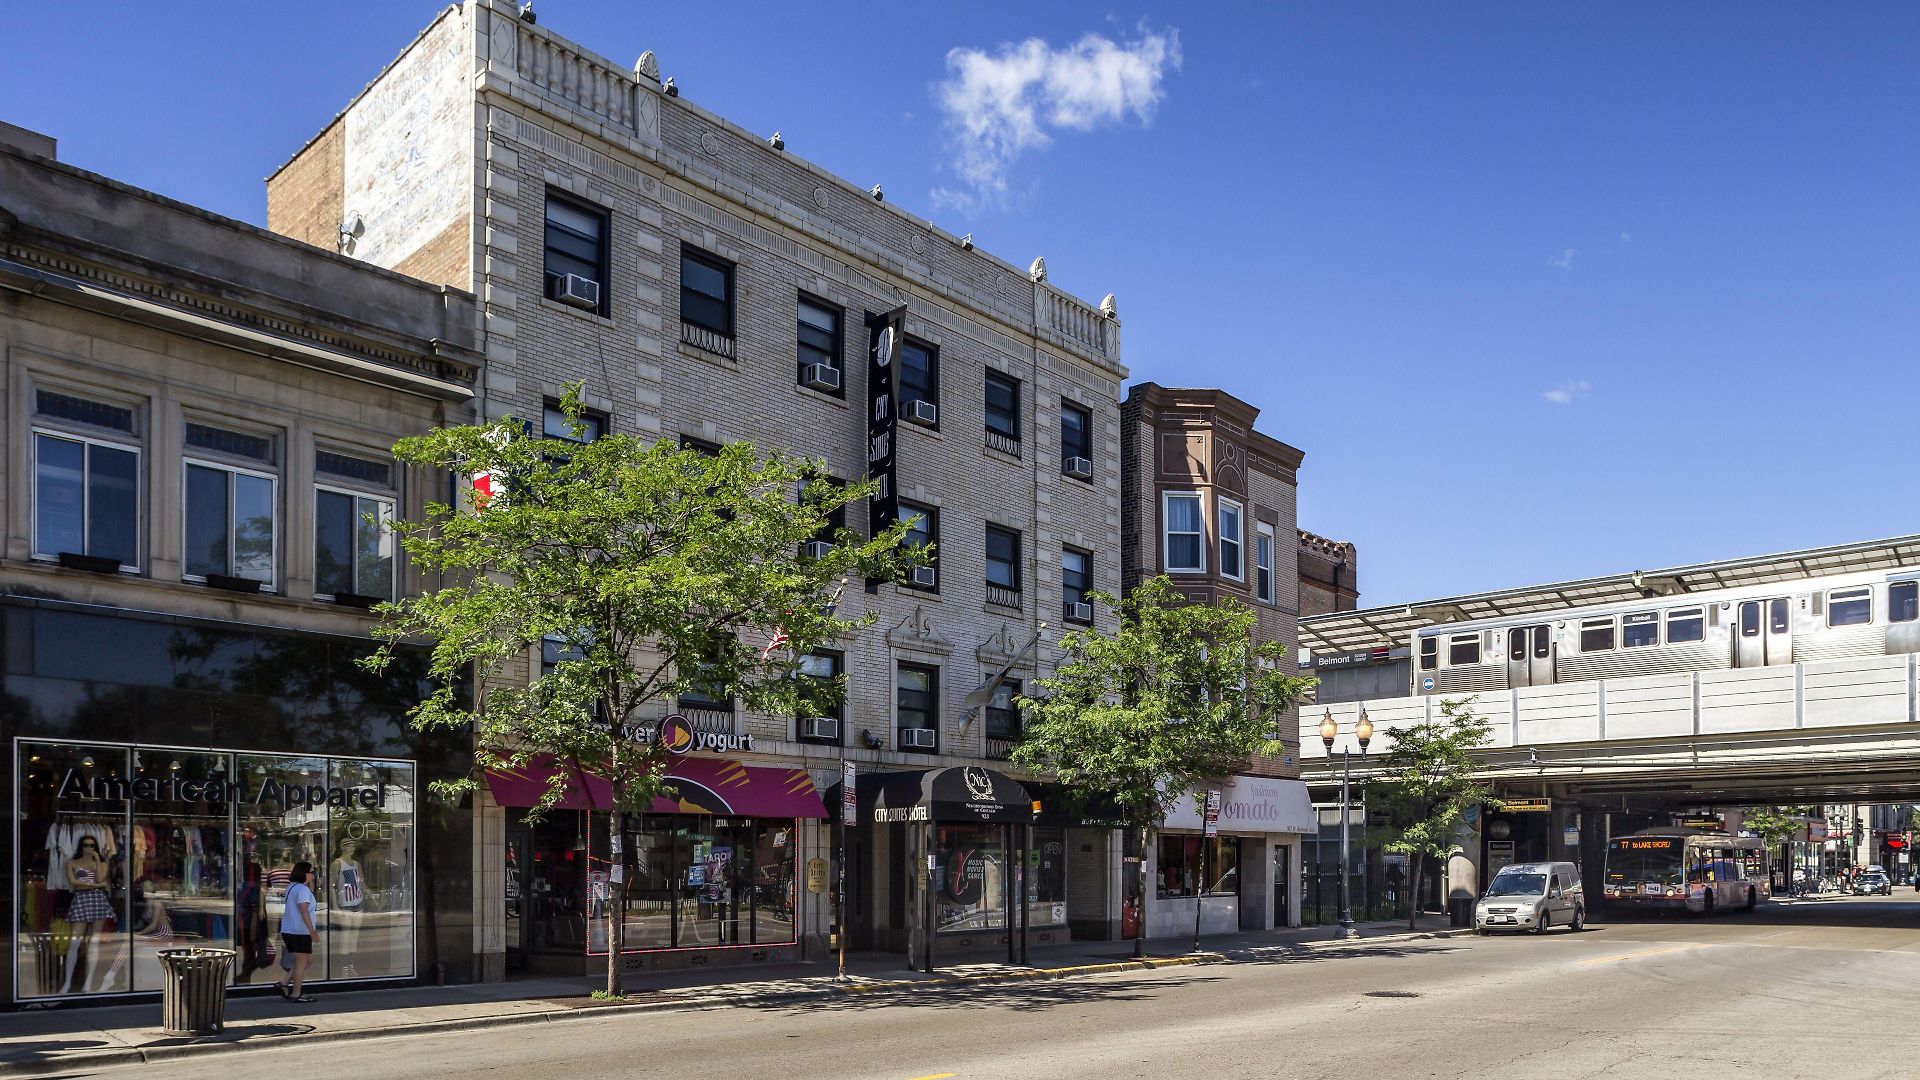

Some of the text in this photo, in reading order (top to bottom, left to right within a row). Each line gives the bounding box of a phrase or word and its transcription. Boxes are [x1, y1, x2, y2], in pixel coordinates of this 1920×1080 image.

[875, 393, 889, 421] CITY
[870, 430, 890, 462] SUITES
[1318, 655, 1350, 666] Belmont
[696, 731, 756, 752] yogurt
[57, 767, 387, 811] American Apparel
[1250, 783, 1279, 800] fashion
[875, 808, 888, 822] CITY
[888, 807, 908, 822] SUITES
[348, 820, 408, 840] OPEN
[1620, 841, 1629, 849] 77
[1631, 841, 1639, 849] to
[1638, 841, 1652, 849] LAKE
[703, 852, 727, 863] TARO
